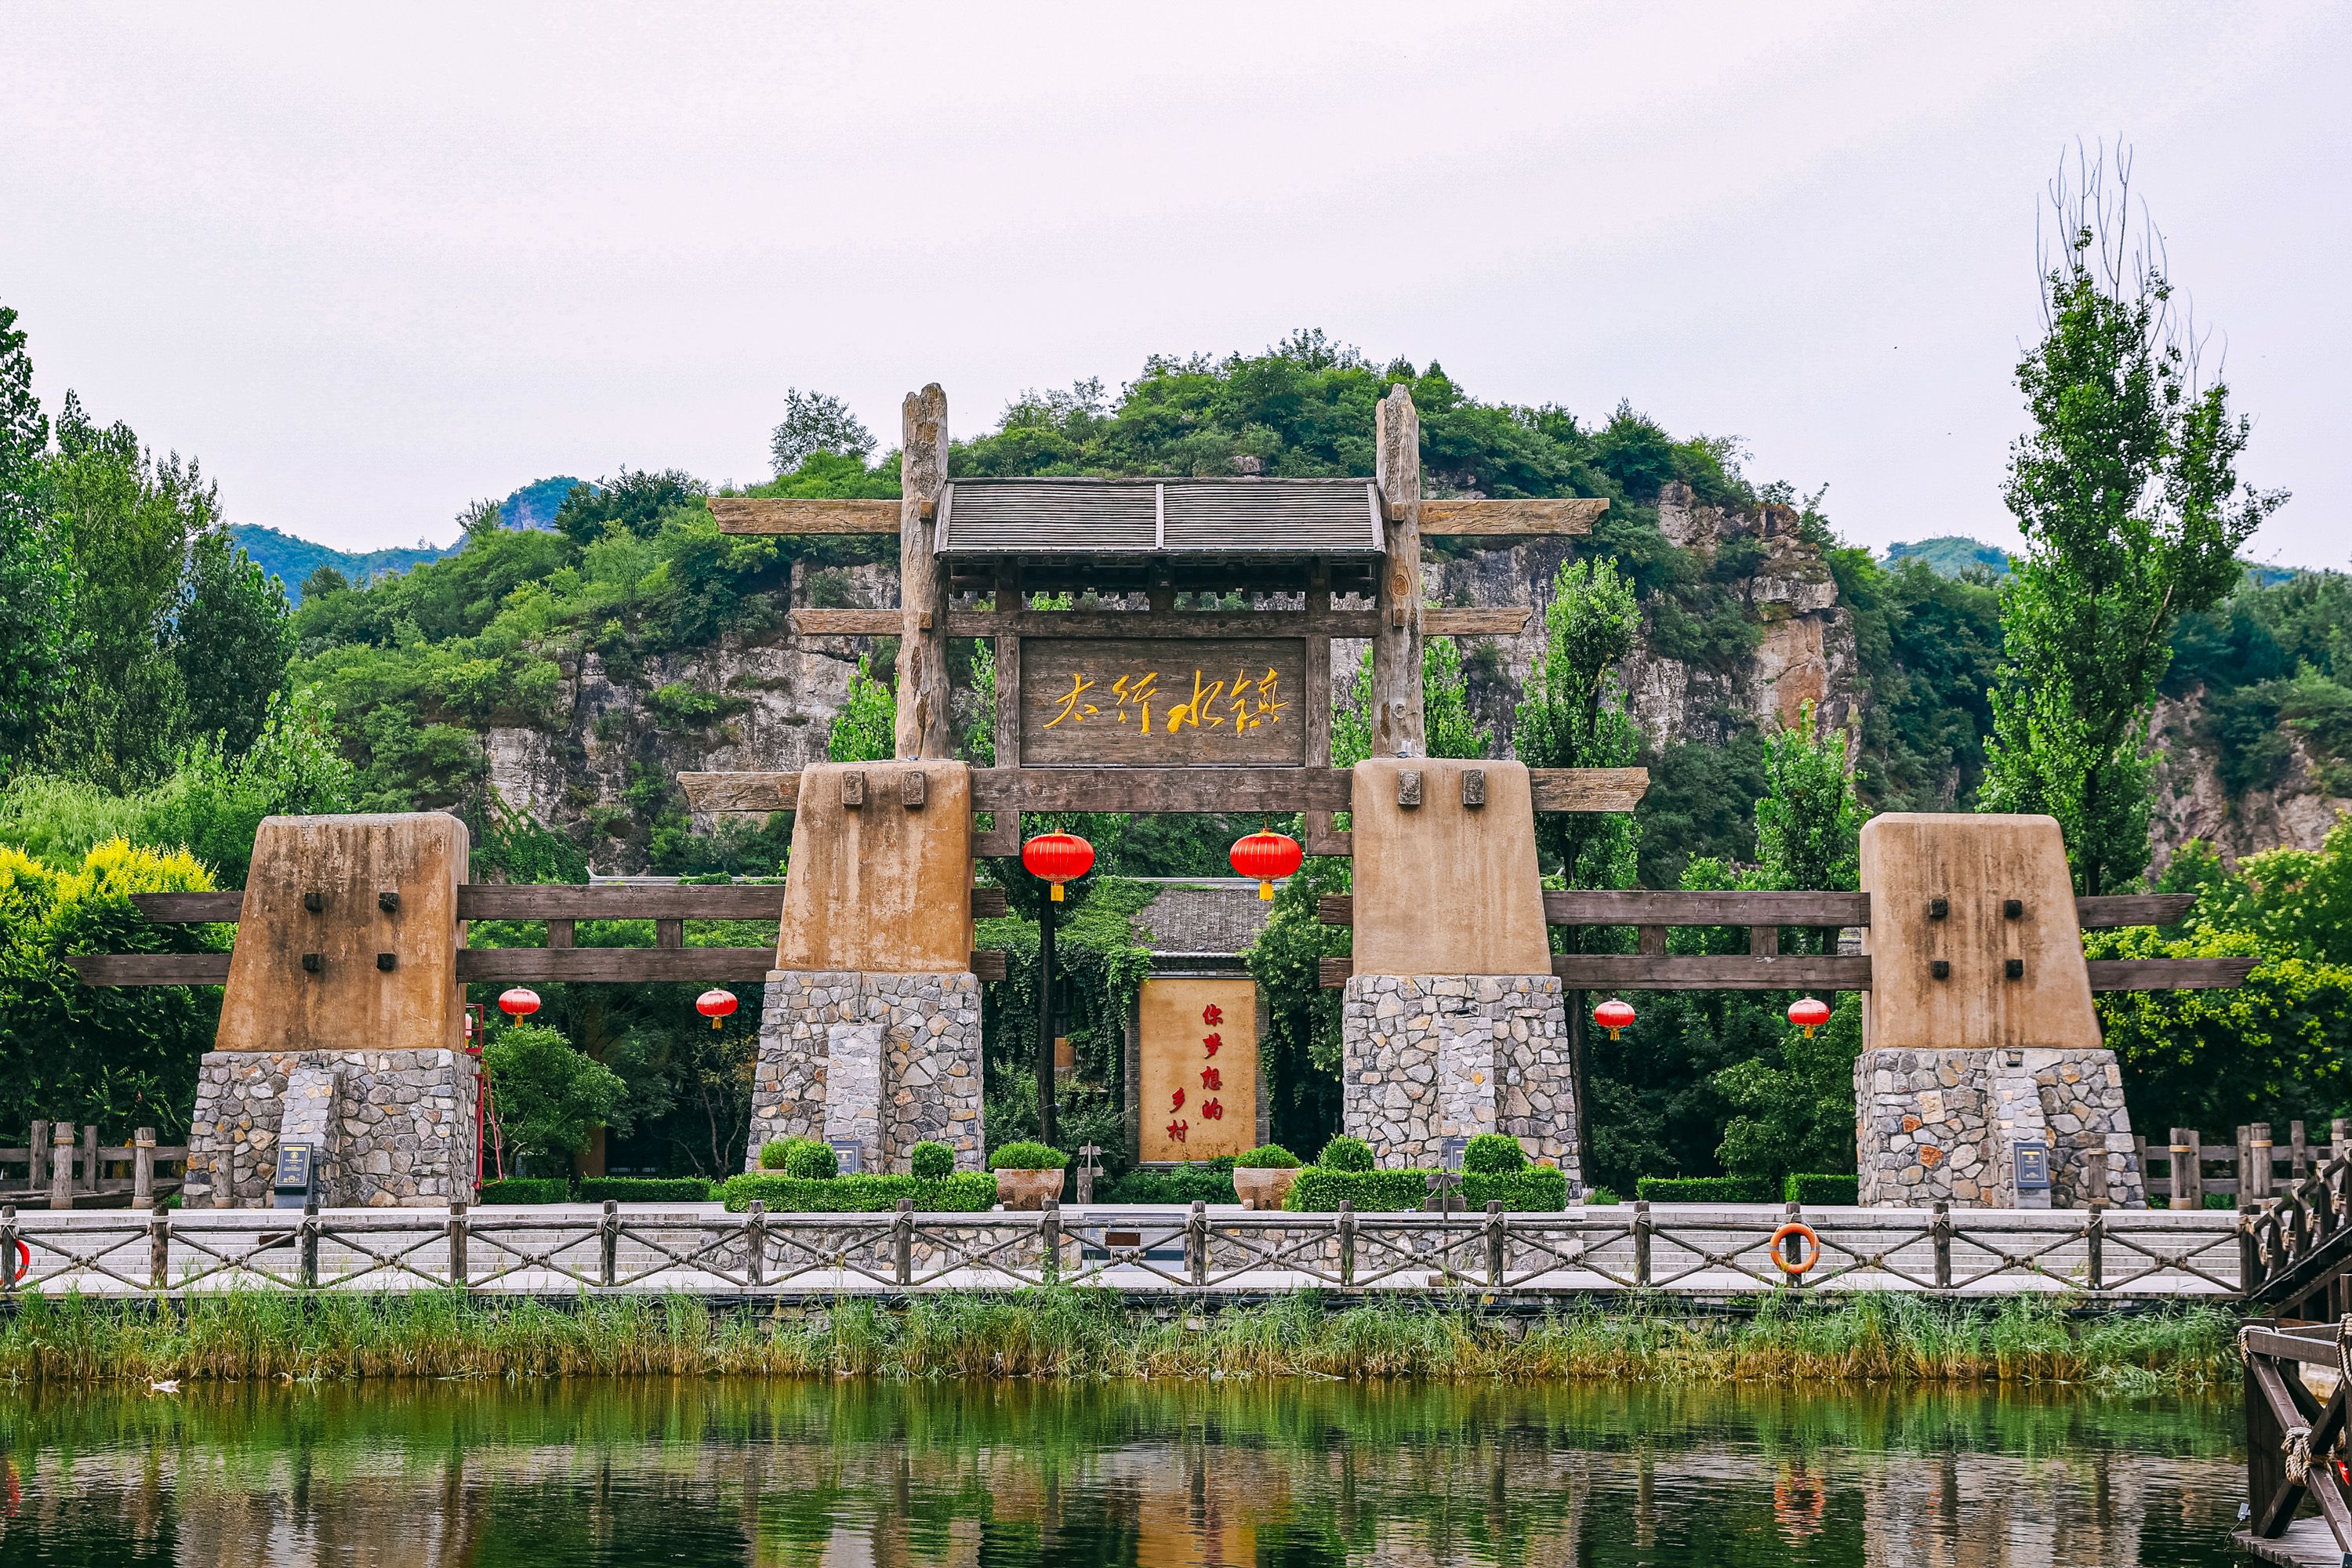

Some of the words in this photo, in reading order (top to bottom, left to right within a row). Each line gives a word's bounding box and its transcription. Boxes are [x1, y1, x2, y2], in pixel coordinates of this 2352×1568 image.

[1043, 667, 1288, 734] 太行水镇
[1200, 1004, 1223, 1121] 你梦想的
[1166, 1087, 1189, 1143] 乡村
